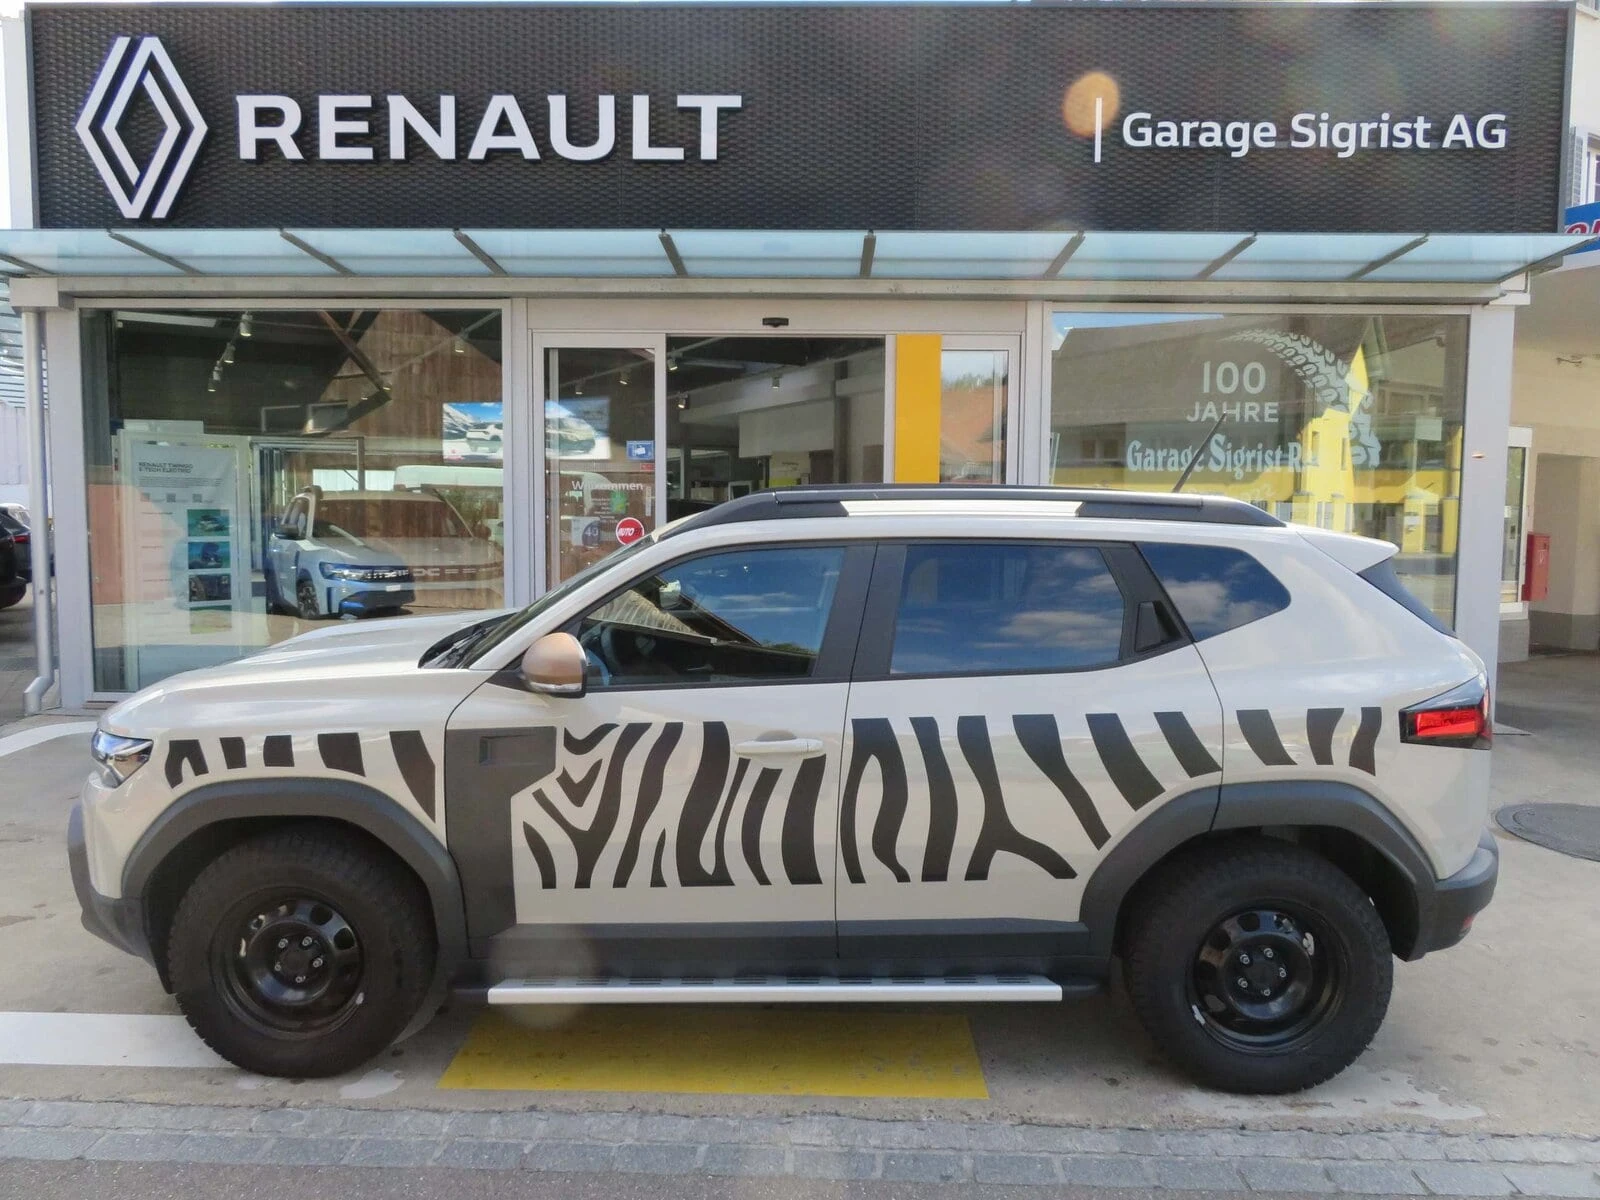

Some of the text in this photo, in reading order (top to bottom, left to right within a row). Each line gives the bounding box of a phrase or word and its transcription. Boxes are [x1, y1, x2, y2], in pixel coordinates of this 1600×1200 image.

[236, 94, 743, 162] RENAULT
[1122, 112, 1507, 158] Garage Sigrist AG
[1201, 361, 1266, 394] 100
[1186, 401, 1279, 423] JAHRE
[1207, 433, 1282, 480] Sigrist
